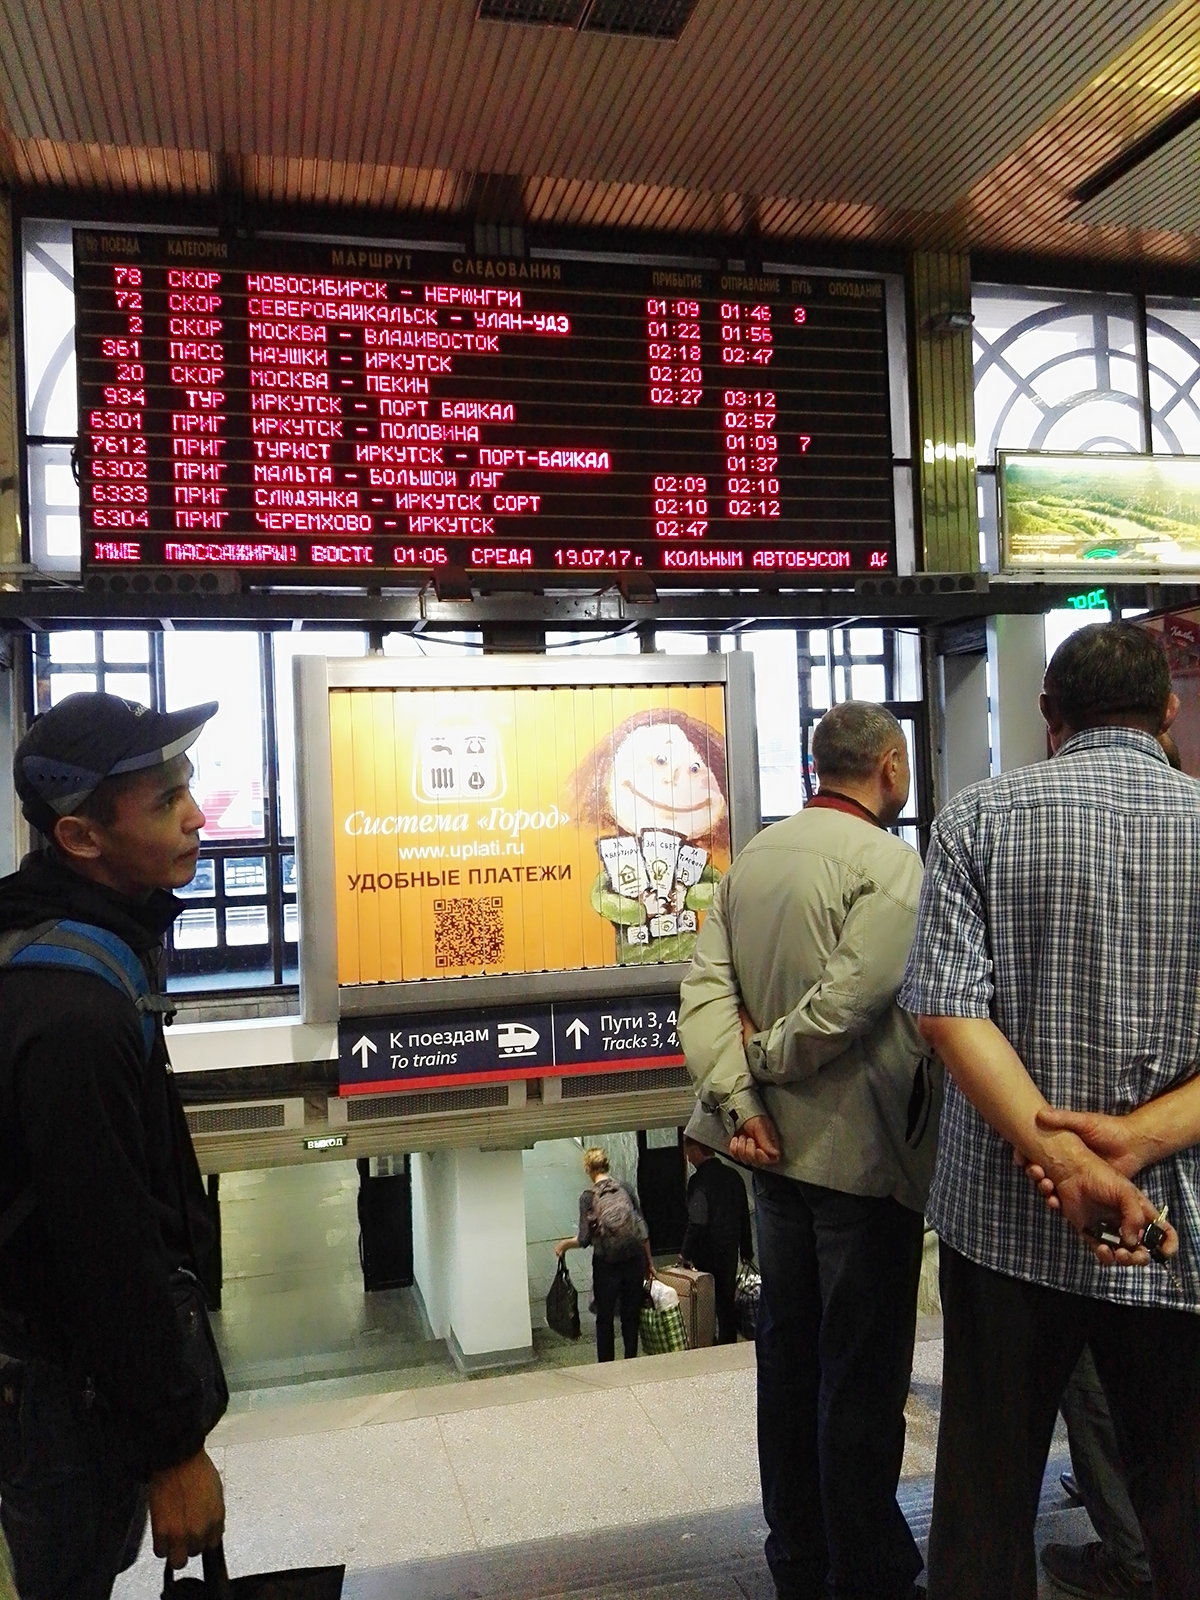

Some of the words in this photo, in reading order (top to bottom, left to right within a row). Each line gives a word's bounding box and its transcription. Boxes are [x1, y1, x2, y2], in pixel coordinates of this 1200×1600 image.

[102, 237, 140, 255] ПОЕЗДА
[168, 240, 228, 258] КАТЕГОРИЯ
[332, 250, 412, 270] МАРШРУТ
[452, 259, 561, 281] СЛЕДОВАНИЯ
[652, 271, 702, 288] ПРИБЫТИЕ
[721, 275, 780, 293] ОТПРАВЛЕНИЕ
[791, 279, 812, 294] ПУТЬ
[828, 282, 882, 298] ОПОЗДАНИЕ
[115, 267, 141, 285] 78
[169, 271, 220, 288] СКОР
[248, 275, 387, 299] НОВОСИБИРСК
[425, 286, 521, 307] НЕРЮНГРИ
[648, 300, 699, 317] 01:09
[721, 304, 771, 320] 01:46
[795, 308, 805, 322] 3
[115, 291, 142, 308] 72
[170, 295, 221, 312] СКОР
[249, 299, 437, 325] СЕВЕРОБАЙКАЛЬСК
[474, 312, 569, 332] УЛАН-УДЭ
[649, 322, 700, 339] 01:22
[722, 326, 772, 342] 01:56
[130, 316, 142, 332] 2
[170, 318, 222, 336] СКОР
[249, 322, 326, 342] МОСКВА
[365, 328, 499, 351] ВЛАДИВОСТОК
[649, 344, 700, 360] 02:18
[723, 347, 773, 364] 02:47
[103, 340, 138, 357] 361
[170, 342, 223, 360] ПАСС
[250, 346, 327, 366] НАУШКИ
[366, 352, 451, 372] ИРКУТСК
[650, 366, 701, 382] 02:20
[118, 364, 143, 381] 20
[172, 366, 224, 384] СКОР
[251, 370, 328, 389] МОСКВА
[367, 375, 428, 393] ПЕКИН
[651, 388, 702, 404] 02:27
[725, 391, 775, 407] 03:12
[105, 388, 144, 405] 934
[186, 391, 224, 408] ТУР
[252, 394, 342, 413] ИРКУТСК
[380, 399, 428, 417] ПОРТ
[442, 402, 513, 420] БАЙКАЛ
[725, 412, 775, 428] 02:57
[91, 412, 141, 429] 6301
[173, 415, 225, 432] ПРИГ
[253, 418, 343, 437] ИРКУТСК
[381, 423, 478, 442] ПОЛОВИНА
[727, 435, 777, 450] 01:09
[800, 437, 810, 451] 7
[91, 436, 146, 454] 7612
[174, 439, 226, 456] ПРИГ
[254, 441, 330, 459] ТУРИСТ
[356, 445, 443, 463] ИРКУТСК
[480, 449, 609, 469] ПОРТ-БАЙКАЛ
[728, 456, 777, 472] 01:37
[92, 460, 147, 478] 6302
[174, 463, 227, 480] ПРИГ
[254, 465, 332, 483] МАЛЬТА
[370, 468, 456, 486] БОЛЬШОЙ
[469, 472, 503, 487] ЛУГ
[655, 477, 706, 492] 02:09
[728, 478, 779, 493] 02:10
[93, 485, 147, 502] 6333
[175, 487, 227, 504] ПРИГ
[255, 489, 358, 507] СЛЮДЯНКА
[396, 493, 481, 510] ИРКУТСК
[494, 495, 540, 511] СОРТ
[655, 499, 707, 514] 02:10
[729, 500, 780, 515] 02:12
[94, 509, 148, 526] 6304
[176, 511, 229, 528] ПРИГ
[256, 513, 371, 531] ЧЕРЕМХОВО
[409, 516, 494, 533] ИРКУТСК
[656, 521, 708, 536] 02:47
[394, 547, 447, 563] 01:06
[472, 548, 531, 564] СРЕДА
[664, 551, 742, 566] КОЛЬНЫМ
[753, 551, 850, 566] АВТОБУСОМ
[344, 809, 469, 836] Система
[477, 804, 570, 839] «Город»
[398, 843, 525, 861] www.uplati.ru
[347, 869, 461, 893] УДОБНЫЕ
[468, 864, 572, 885] ПЛАТЕЖИ
[390, 1032, 402, 1048] К
[408, 1028, 489, 1049] поездам
[601, 1015, 643, 1035] Пути
[647, 1011, 662, 1029] 3,
[666, 1010, 678, 1026] 4
[602, 1034, 648, 1051] Tracks
[650, 1033, 663, 1048] 3,
[390, 1055, 409, 1069] To
[412, 1052, 458, 1068] trains
[307, 1137, 343, 1149] ВЫХОД
